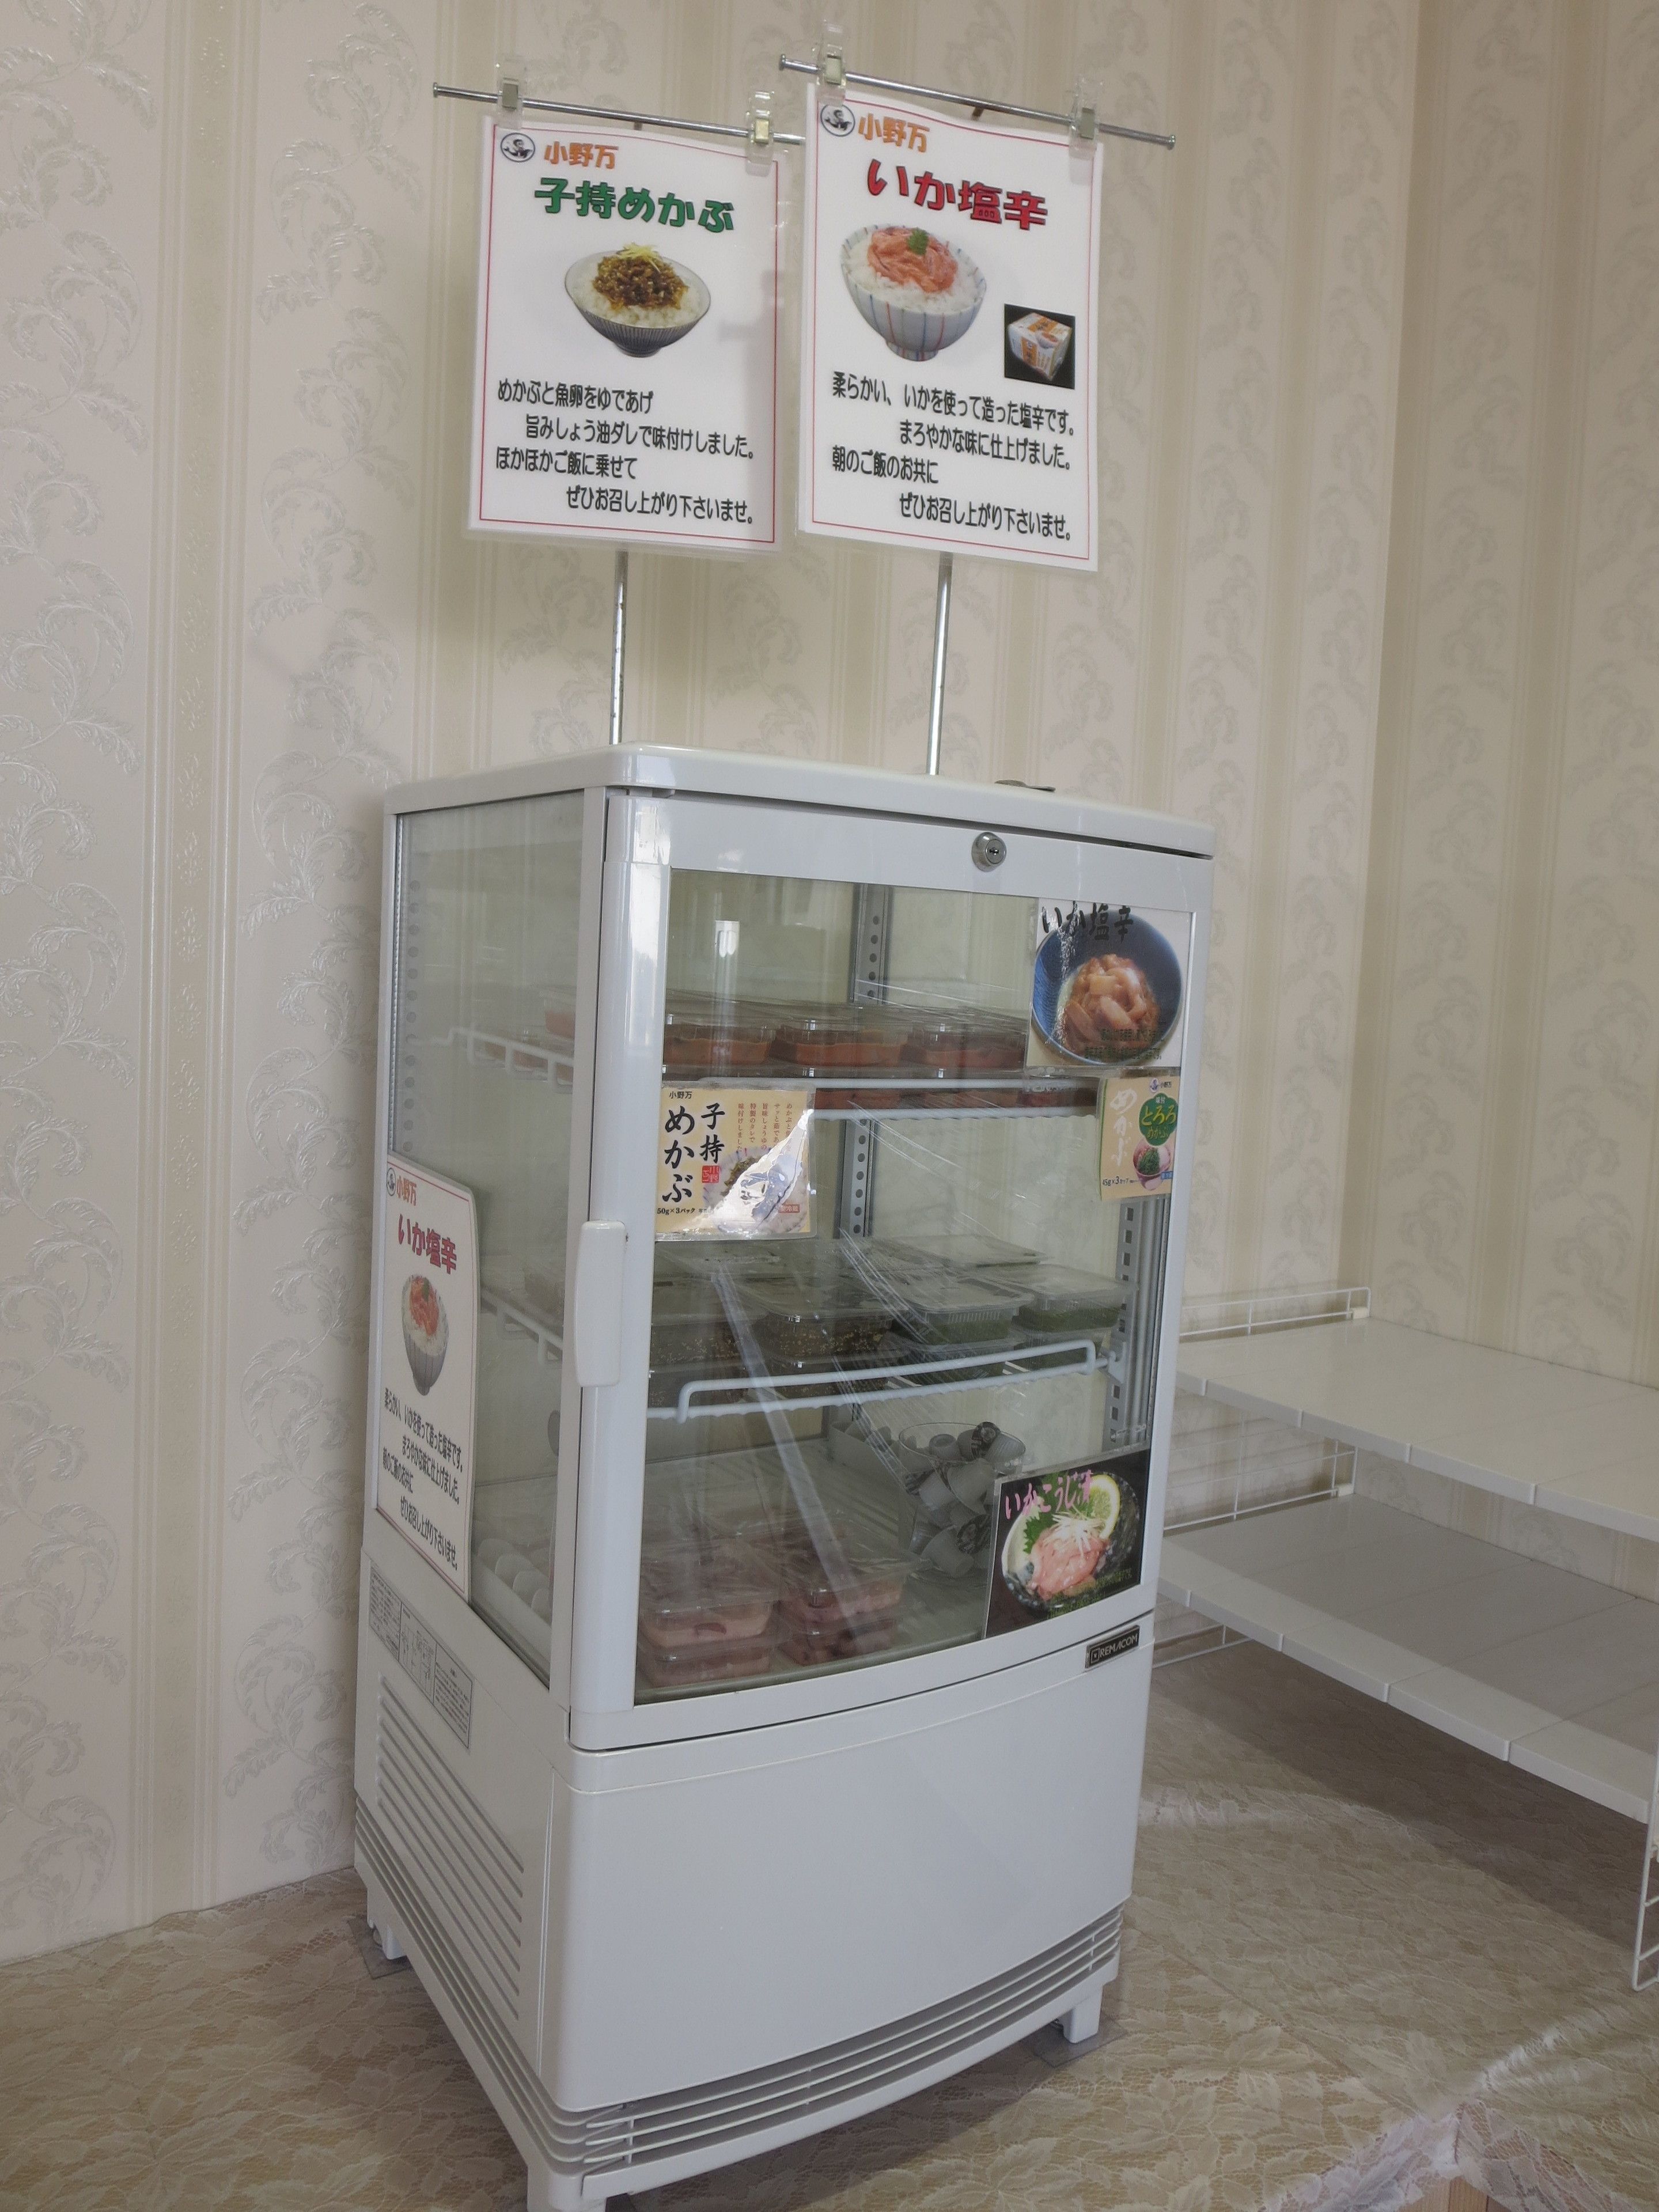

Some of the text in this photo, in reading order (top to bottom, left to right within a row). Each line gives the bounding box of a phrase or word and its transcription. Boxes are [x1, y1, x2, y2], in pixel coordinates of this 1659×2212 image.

[858, 112, 929, 153] 小野万
[544, 141, 619, 170] 小野万
[535, 177, 734, 233] 子持めかぶ
[867, 159, 1048, 230] いか塩辛
[497, 378, 654, 414] めかぶと魚卵をゆであげ
[525, 414, 753, 460] 旨みしょう油ダレで味付けしました。
[900, 419, 1070, 470] まろやかな味に仕上げました。
[495, 446, 638, 479] ほかほかご飯に乗せて
[832, 445, 939, 484] 朝のご飯のお共に
[566, 484, 753, 525] ぜひお召し上がり下さいませ。
[899, 491, 1070, 541] ぜひお召し上がり下さいませ。
[669, 1090, 693, 1099] 小野万
[1142, 1104, 1176, 1126] とろろ
[699, 1102, 726, 1164] 子持
[662, 1105, 695, 1203] めかぶ
[396, 1175, 417, 1206] 小野万
[397, 1213, 457, 1275] いか塩辛
[1100, 1633, 1138, 1658] REMACOM
